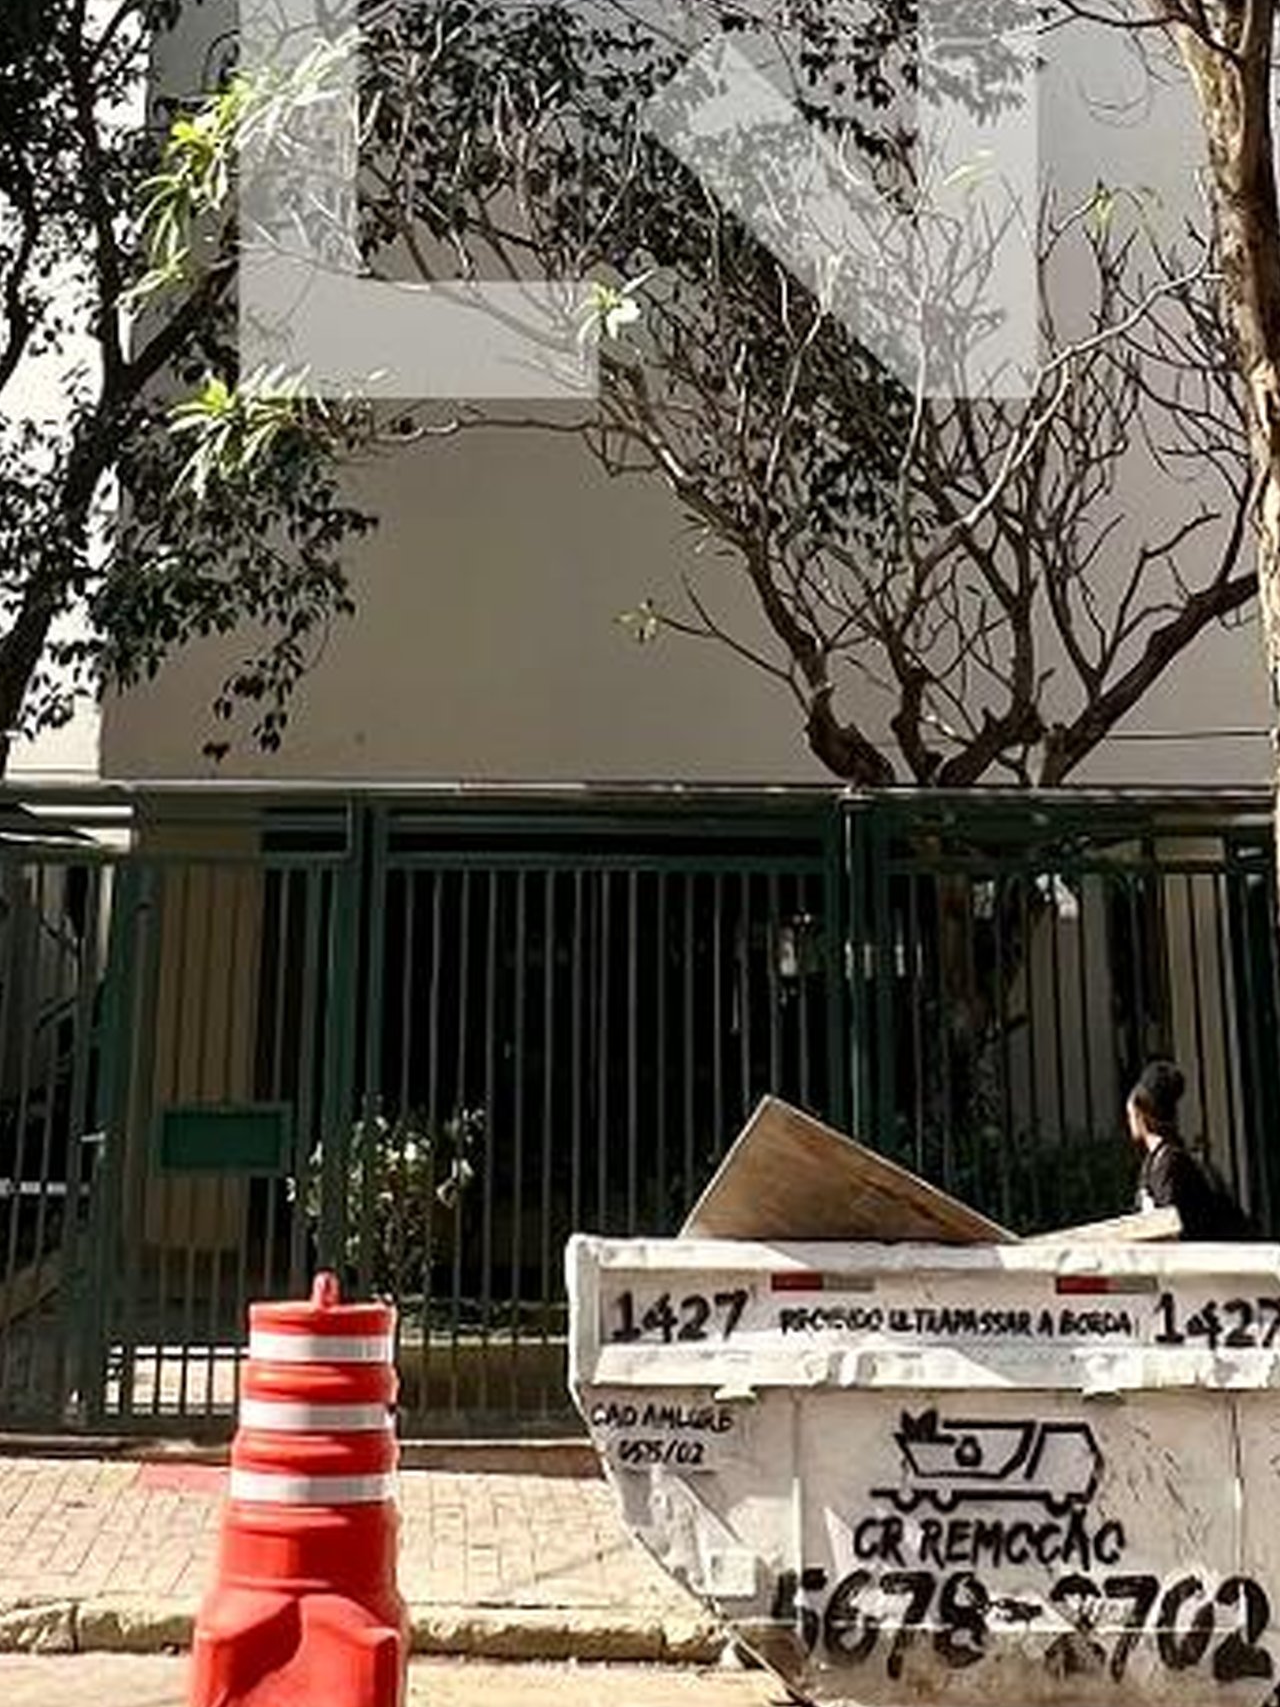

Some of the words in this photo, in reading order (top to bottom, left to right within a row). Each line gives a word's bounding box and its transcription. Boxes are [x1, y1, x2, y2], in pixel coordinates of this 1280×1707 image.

[612, 1290, 749, 1343] 1427
[1037, 1308, 1054, 1338] A
[853, 1517, 905, 1566] CR
